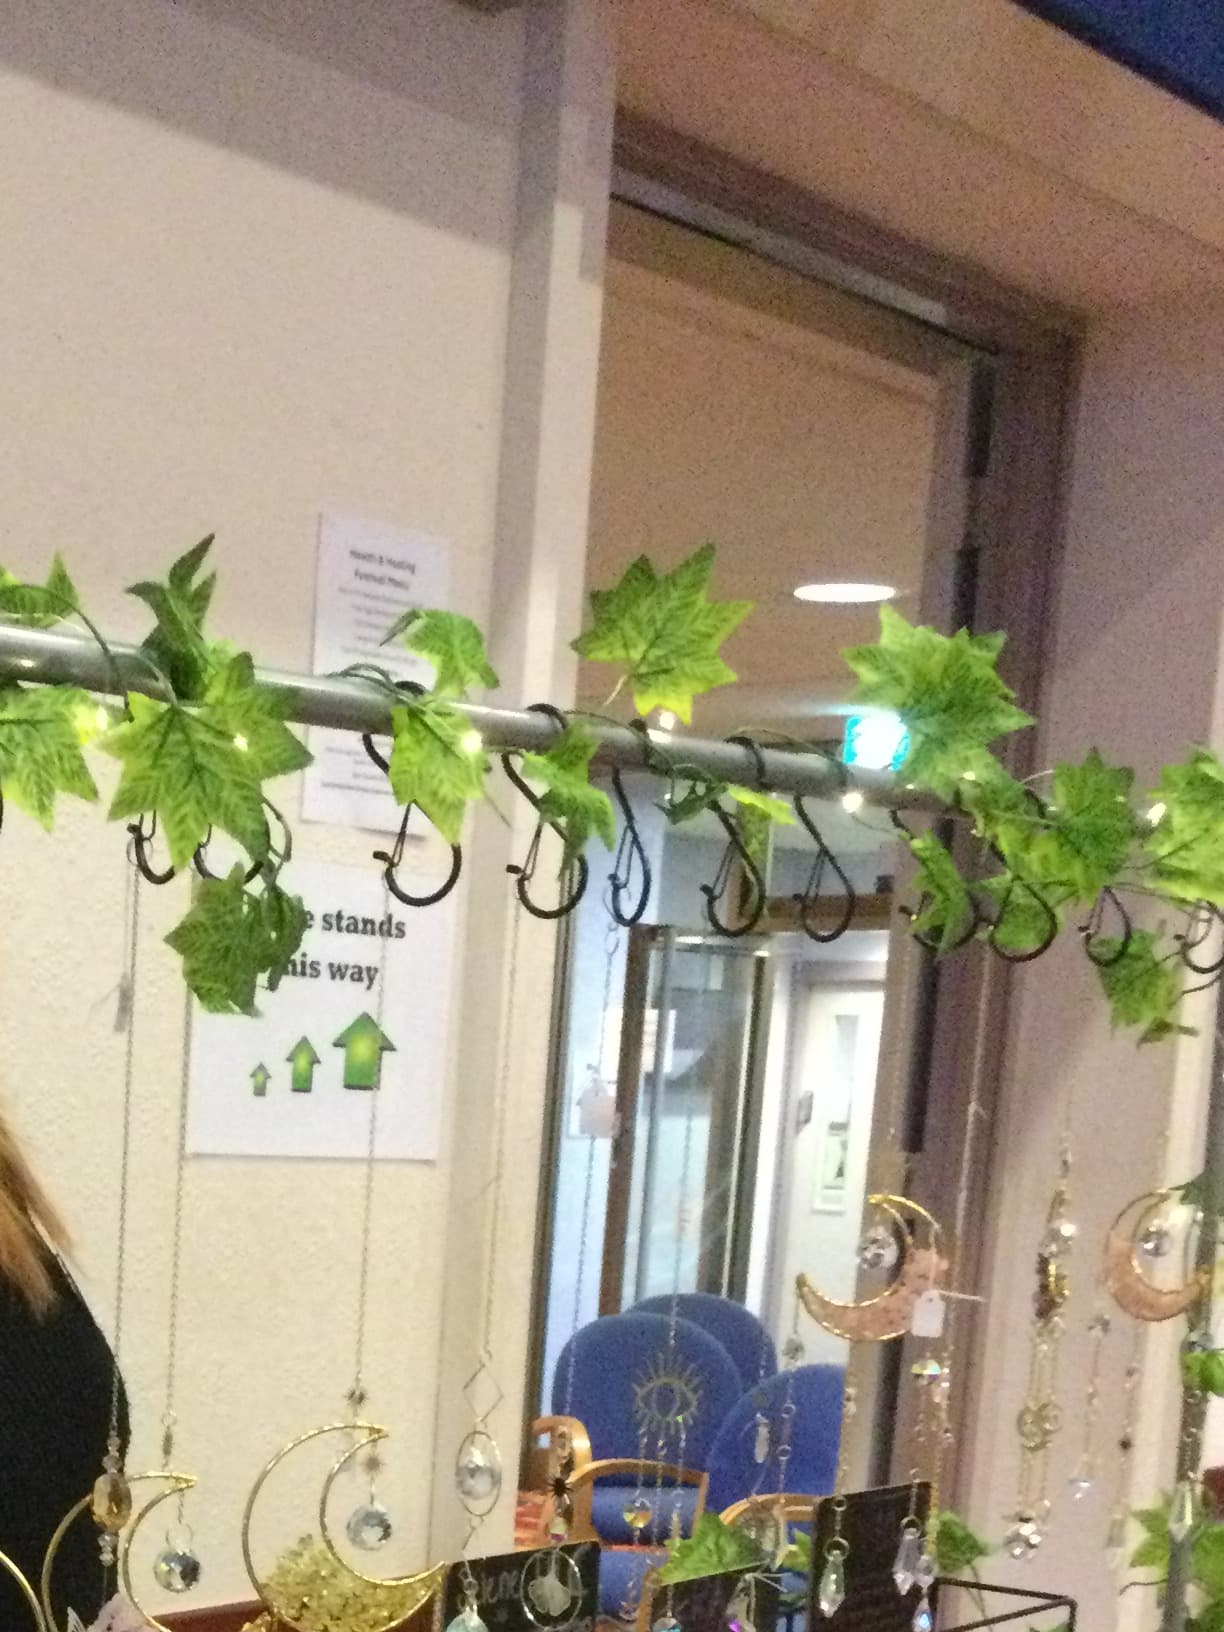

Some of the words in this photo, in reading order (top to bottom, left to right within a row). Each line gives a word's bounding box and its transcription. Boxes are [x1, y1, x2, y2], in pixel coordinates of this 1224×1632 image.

[322, 909, 407, 939] stands
[283, 951, 322, 979] his
[327, 961, 380, 990] way
